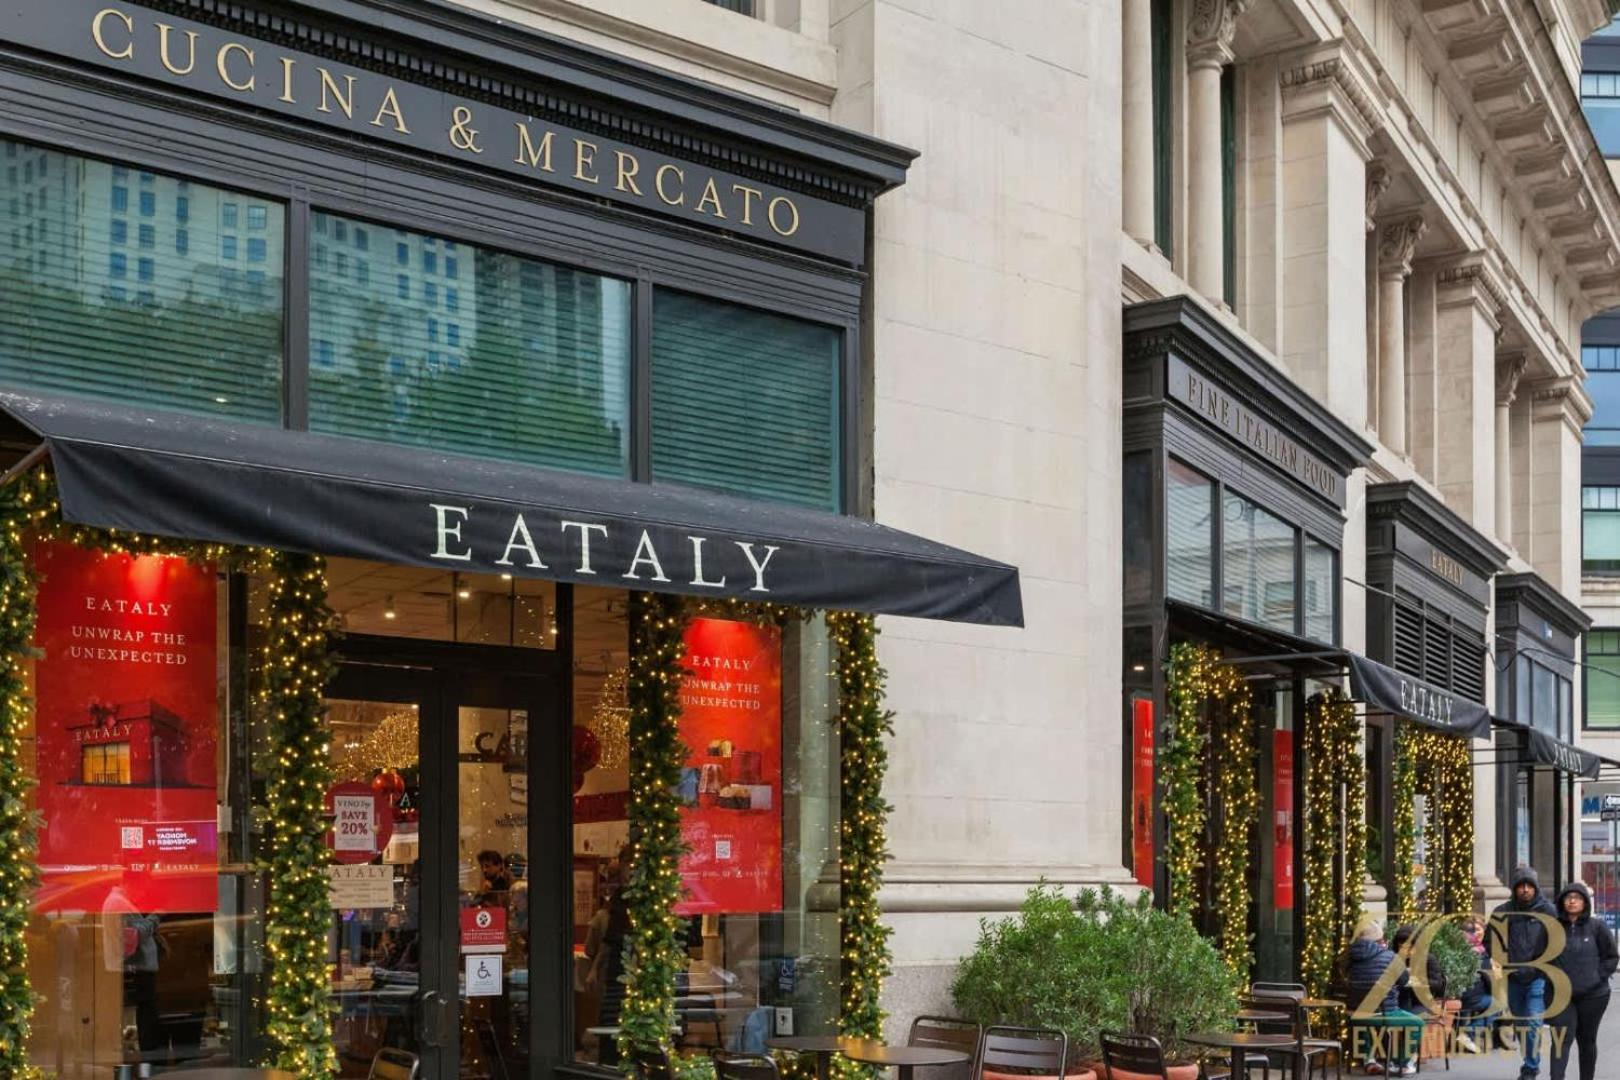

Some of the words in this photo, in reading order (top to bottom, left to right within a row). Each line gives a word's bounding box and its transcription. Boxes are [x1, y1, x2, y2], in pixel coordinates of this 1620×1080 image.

[91, 8, 412, 134] CUCINA
[448, 106, 484, 154] &
[513, 121, 801, 237] MERCATO
[1188, 374, 1230, 427] FINE
[1236, 407, 1297, 473] ITALIAN
[1303, 455, 1336, 497] FOOD
[429, 503, 780, 592] EATALY
[1432, 550, 1463, 586] EATALY
[86, 597, 172, 617] EATALY
[71, 625, 144, 642] UNWRAP
[150, 632, 186, 645] THE
[70, 646, 187, 665] UNEXPECTED
[692, 655, 751, 671] EATALY
[736, 683, 760, 694] THE
[682, 695, 760, 710] UNEXPECTED
[1401, 679, 1453, 726] EATALY
[75, 724, 133, 742] EATALY
[341, 810, 368, 820] SAVE
[341, 822, 368, 835] 20%
[333, 867, 387, 878] ATALY
